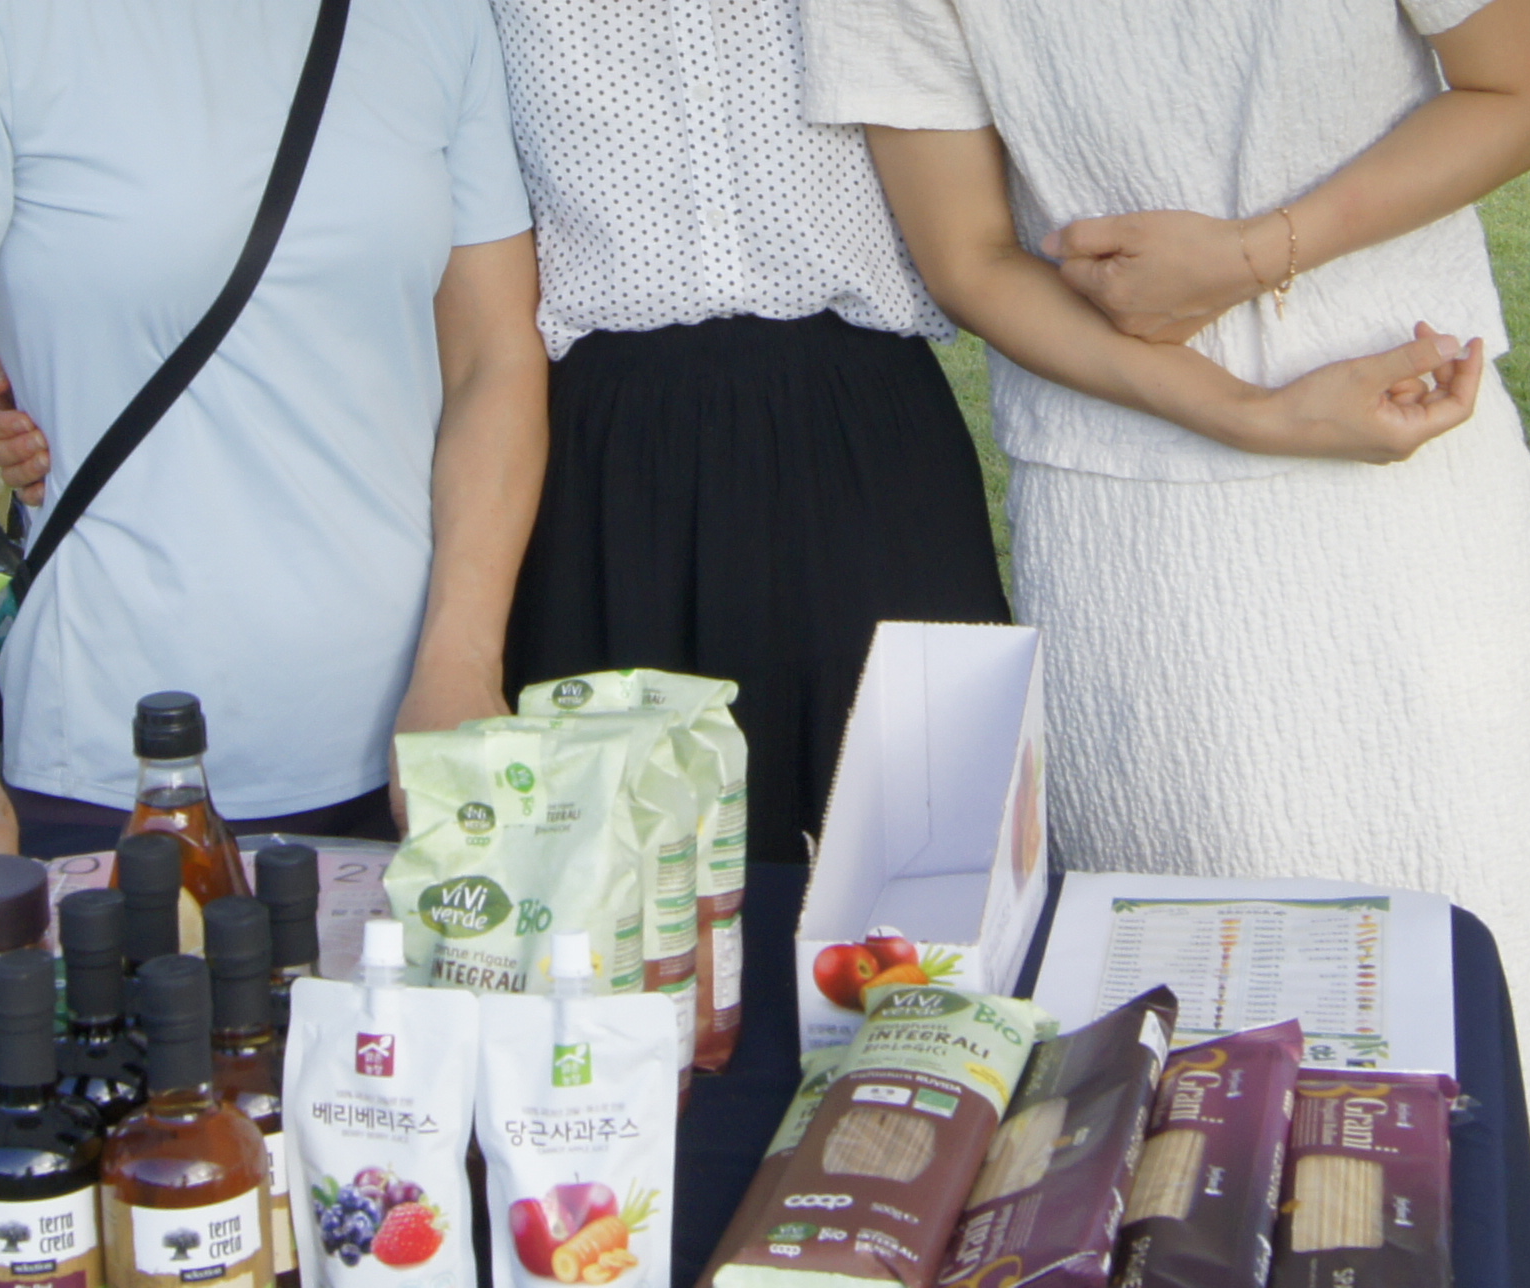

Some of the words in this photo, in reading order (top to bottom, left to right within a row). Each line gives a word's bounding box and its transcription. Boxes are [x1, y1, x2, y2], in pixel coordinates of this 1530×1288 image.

[431, 905, 488, 931] verde
[473, 949, 518, 969] rigate
[312, 1102, 439, 1134] 베리베리주스
[1341, 1097, 1399, 1153] Grani
[505, 1117, 640, 1147] 당근사과주스
[39, 1211, 74, 1234] terra
[208, 1215, 242, 1241] terra
[39, 1232, 75, 1255] creta
[208, 1234, 243, 1260] creta
